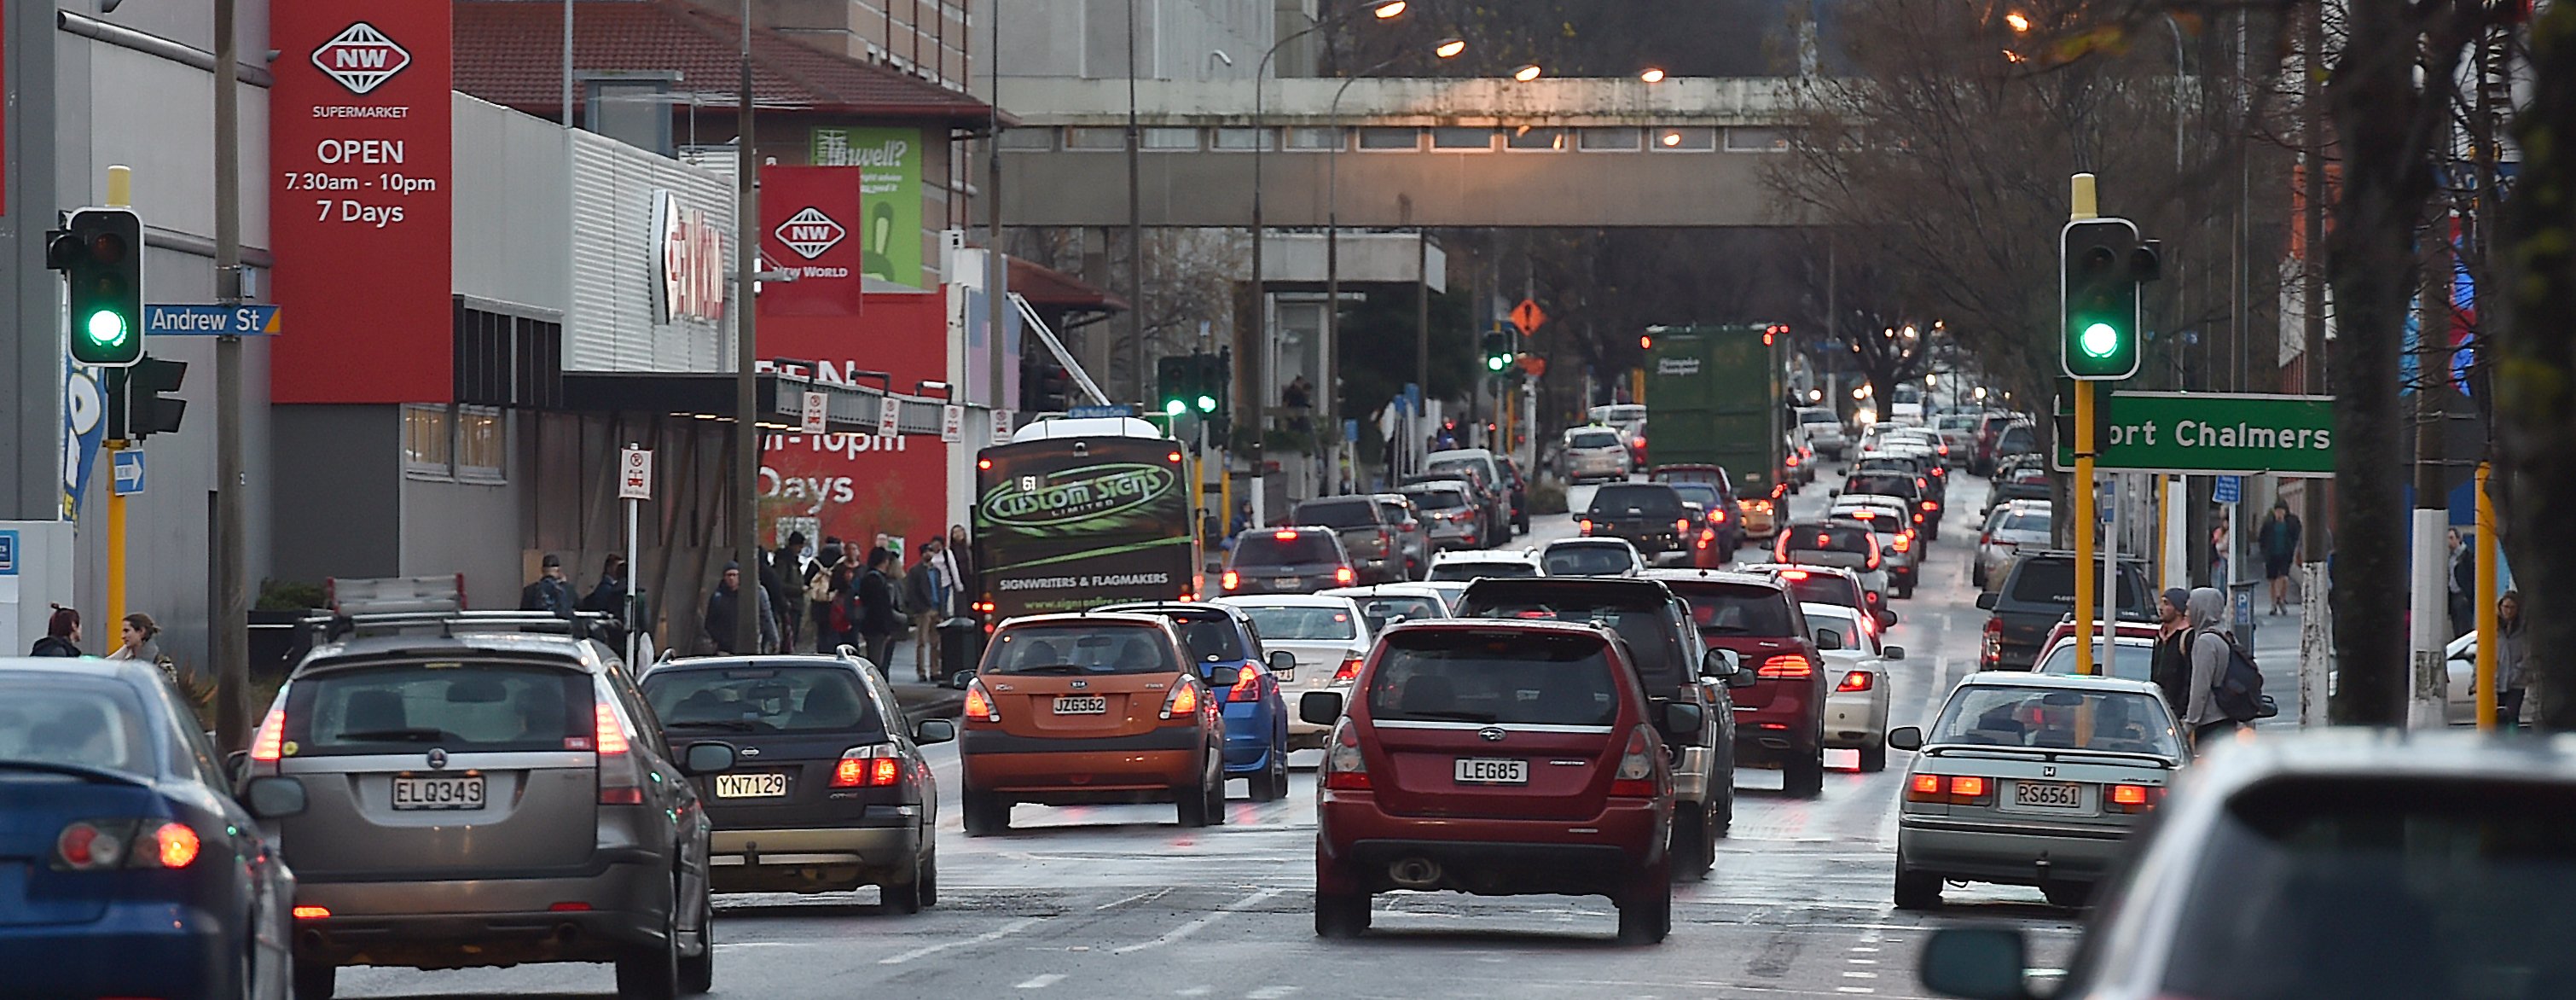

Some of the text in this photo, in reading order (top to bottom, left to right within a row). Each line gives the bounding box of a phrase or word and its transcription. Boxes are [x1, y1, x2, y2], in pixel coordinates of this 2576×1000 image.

[336, 49, 387, 68] NW
[313, 106, 409, 118] SUPERMARKET
[317, 139, 403, 164] OPEN
[285, 172, 358, 190] 7.30am
[380, 173, 436, 195] 10pm
[316, 200, 404, 228] 7 Days
[792, 225, 830, 241] NW
[803, 265, 848, 277] WORLD
[151, 308, 260, 331] Andrew St
[2109, 421, 2330, 450] ort Chalmers
[757, 466, 854, 515] Days
[1022, 475, 1037, 491] 61
[1052, 498, 1114, 517] LIMITED
[1000, 573, 1169, 590] SIGNWRITERS & FLAGMAKERS
[1055, 698, 1105, 712] JZG362
[1463, 762, 1519, 780] LEG85
[719, 776, 784, 795] YN7129
[2017, 785, 2076, 805] RS6561
